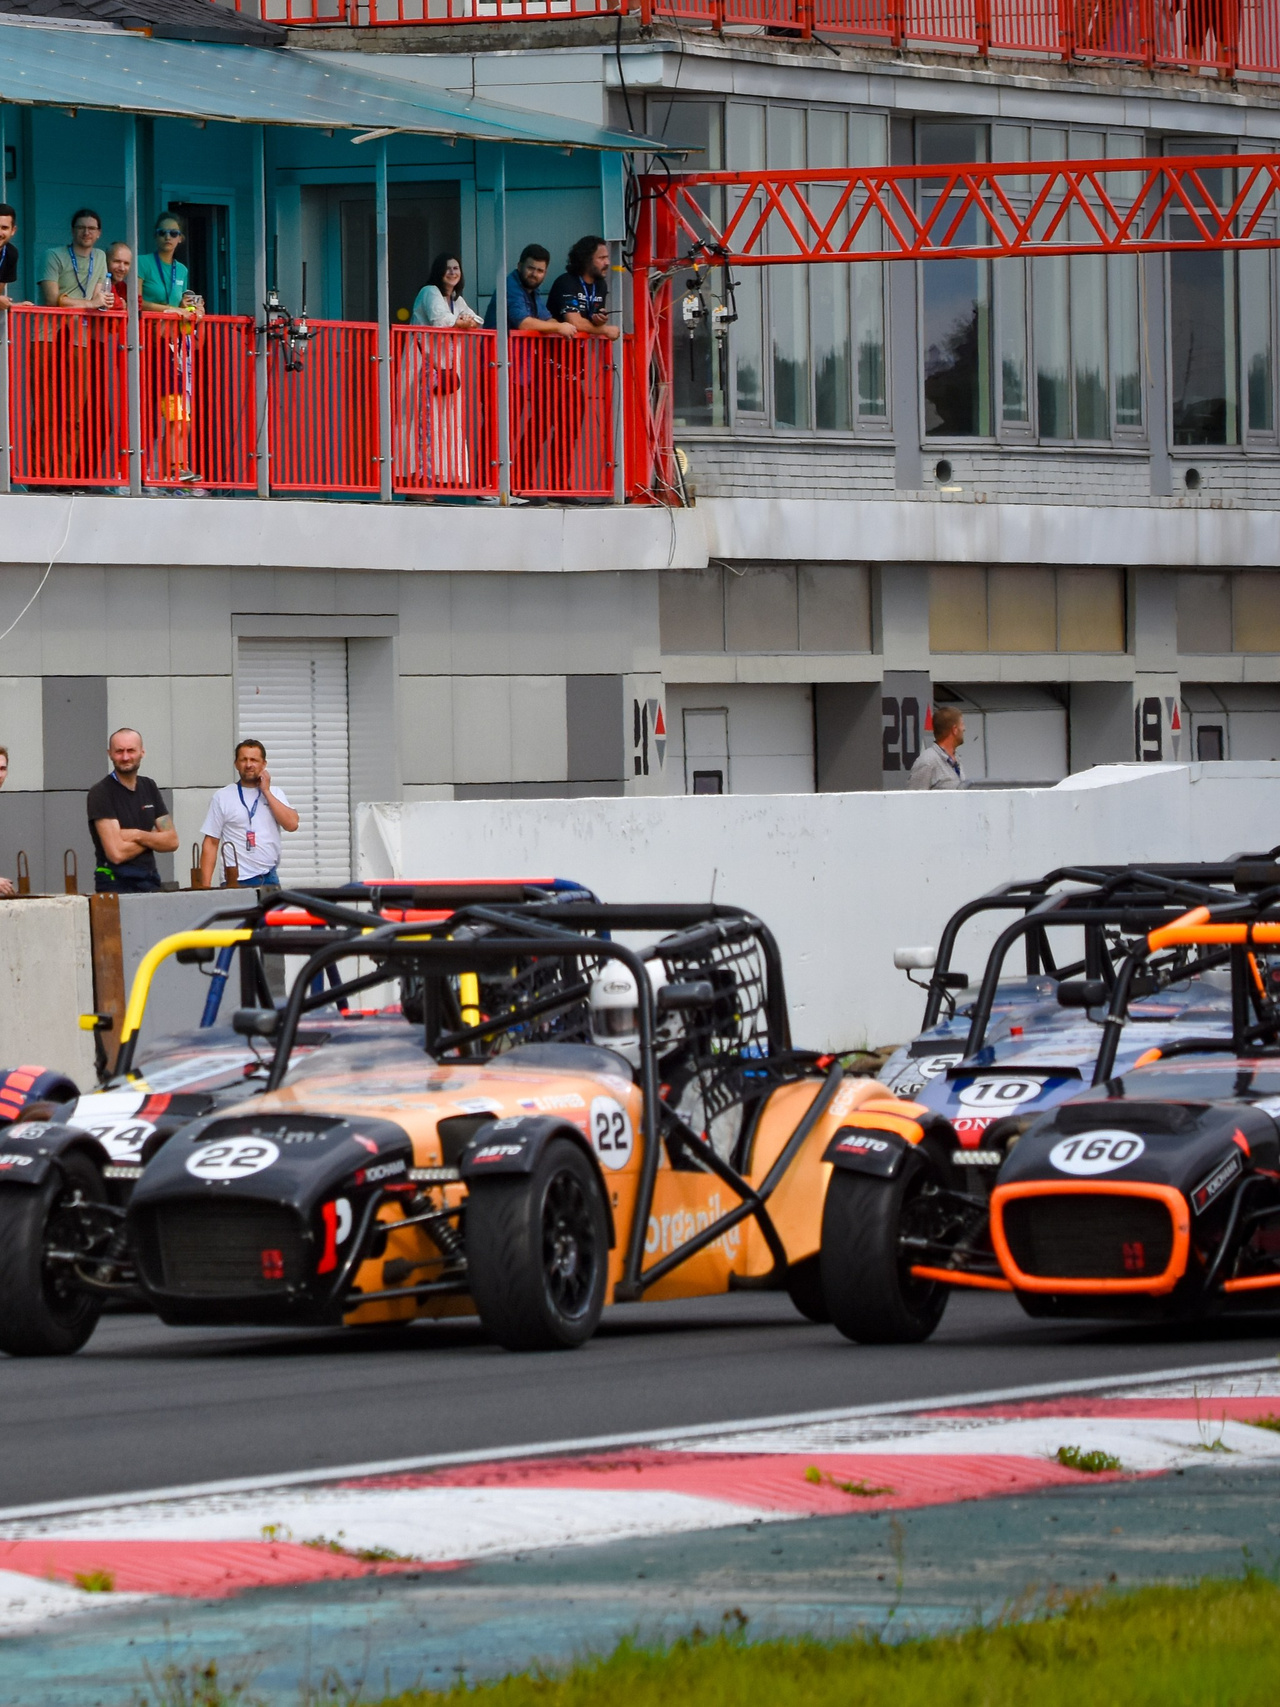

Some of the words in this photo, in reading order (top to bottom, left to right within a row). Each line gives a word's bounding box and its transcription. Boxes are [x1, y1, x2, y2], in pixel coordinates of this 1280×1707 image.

[882, 696, 920, 772] 20
[1134, 696, 1163, 762] 19
[974, 1083, 1027, 1101] 10
[596, 1112, 628, 1151] 22
[195, 1147, 268, 1168] 22
[1064, 1135, 1136, 1163] 160
